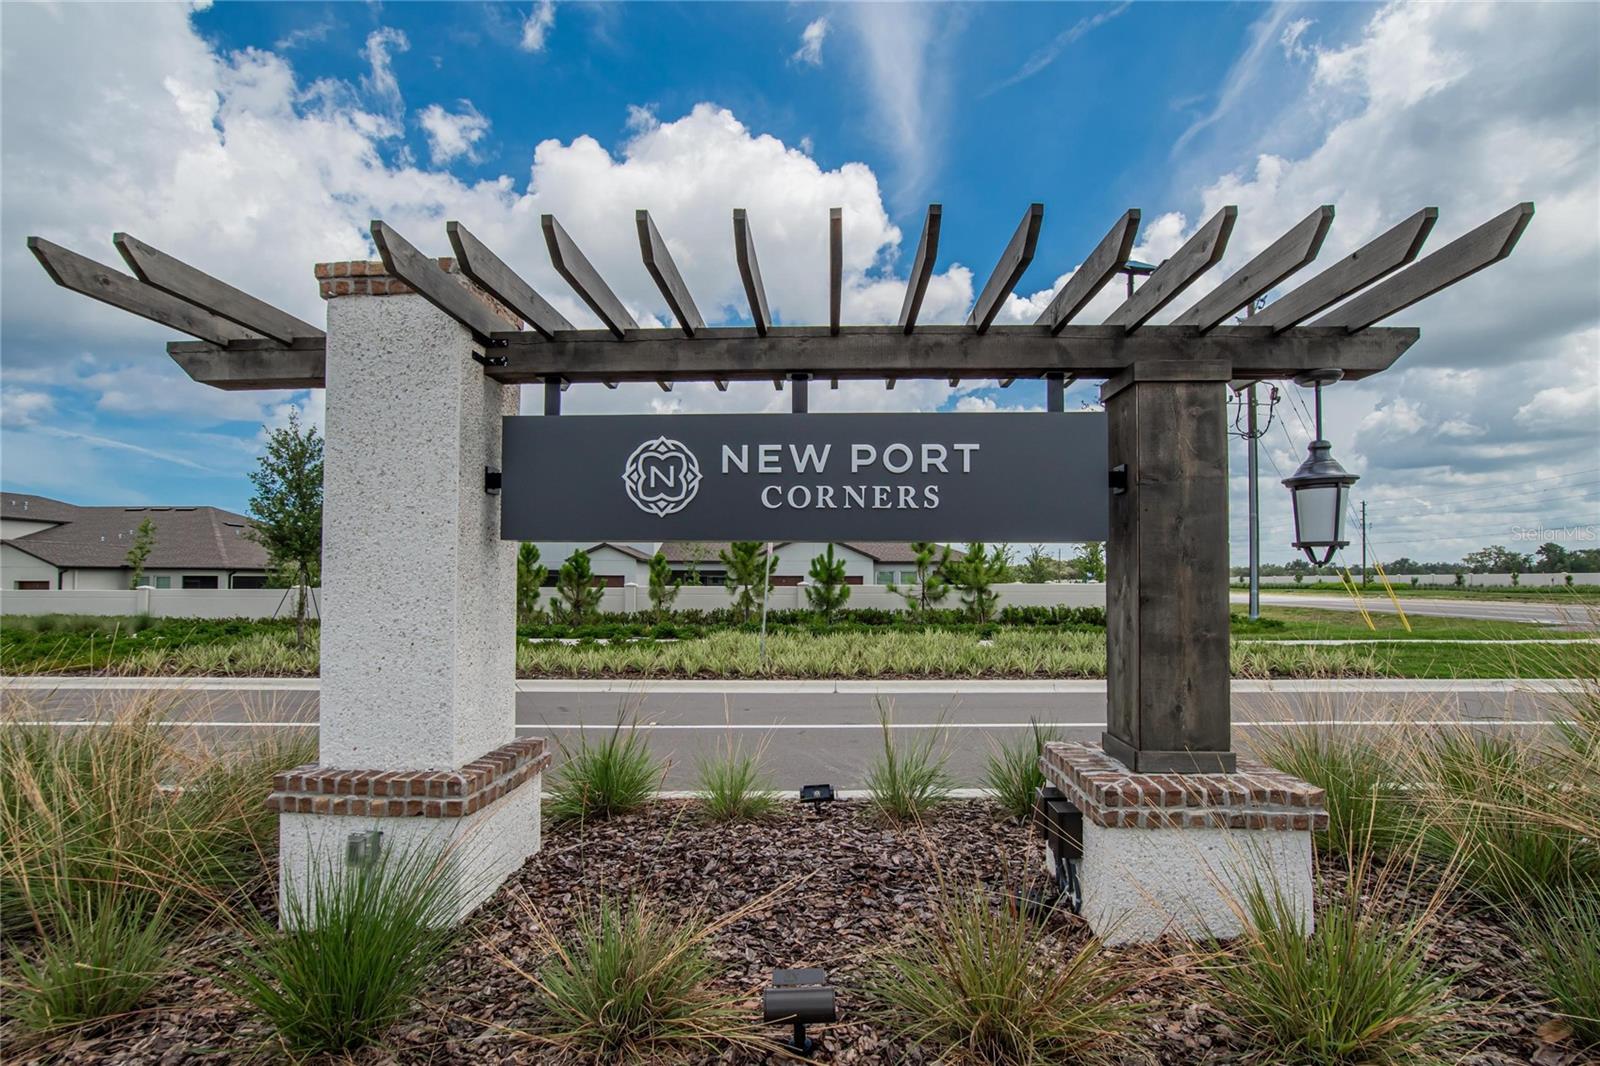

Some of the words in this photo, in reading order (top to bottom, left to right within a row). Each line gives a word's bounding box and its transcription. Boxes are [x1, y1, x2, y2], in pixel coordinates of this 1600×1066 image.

[721, 443, 832, 474] NEW
[850, 442, 981, 474] PORT
[650, 465, 675, 488] N
[760, 484, 940, 509] CORNERS
